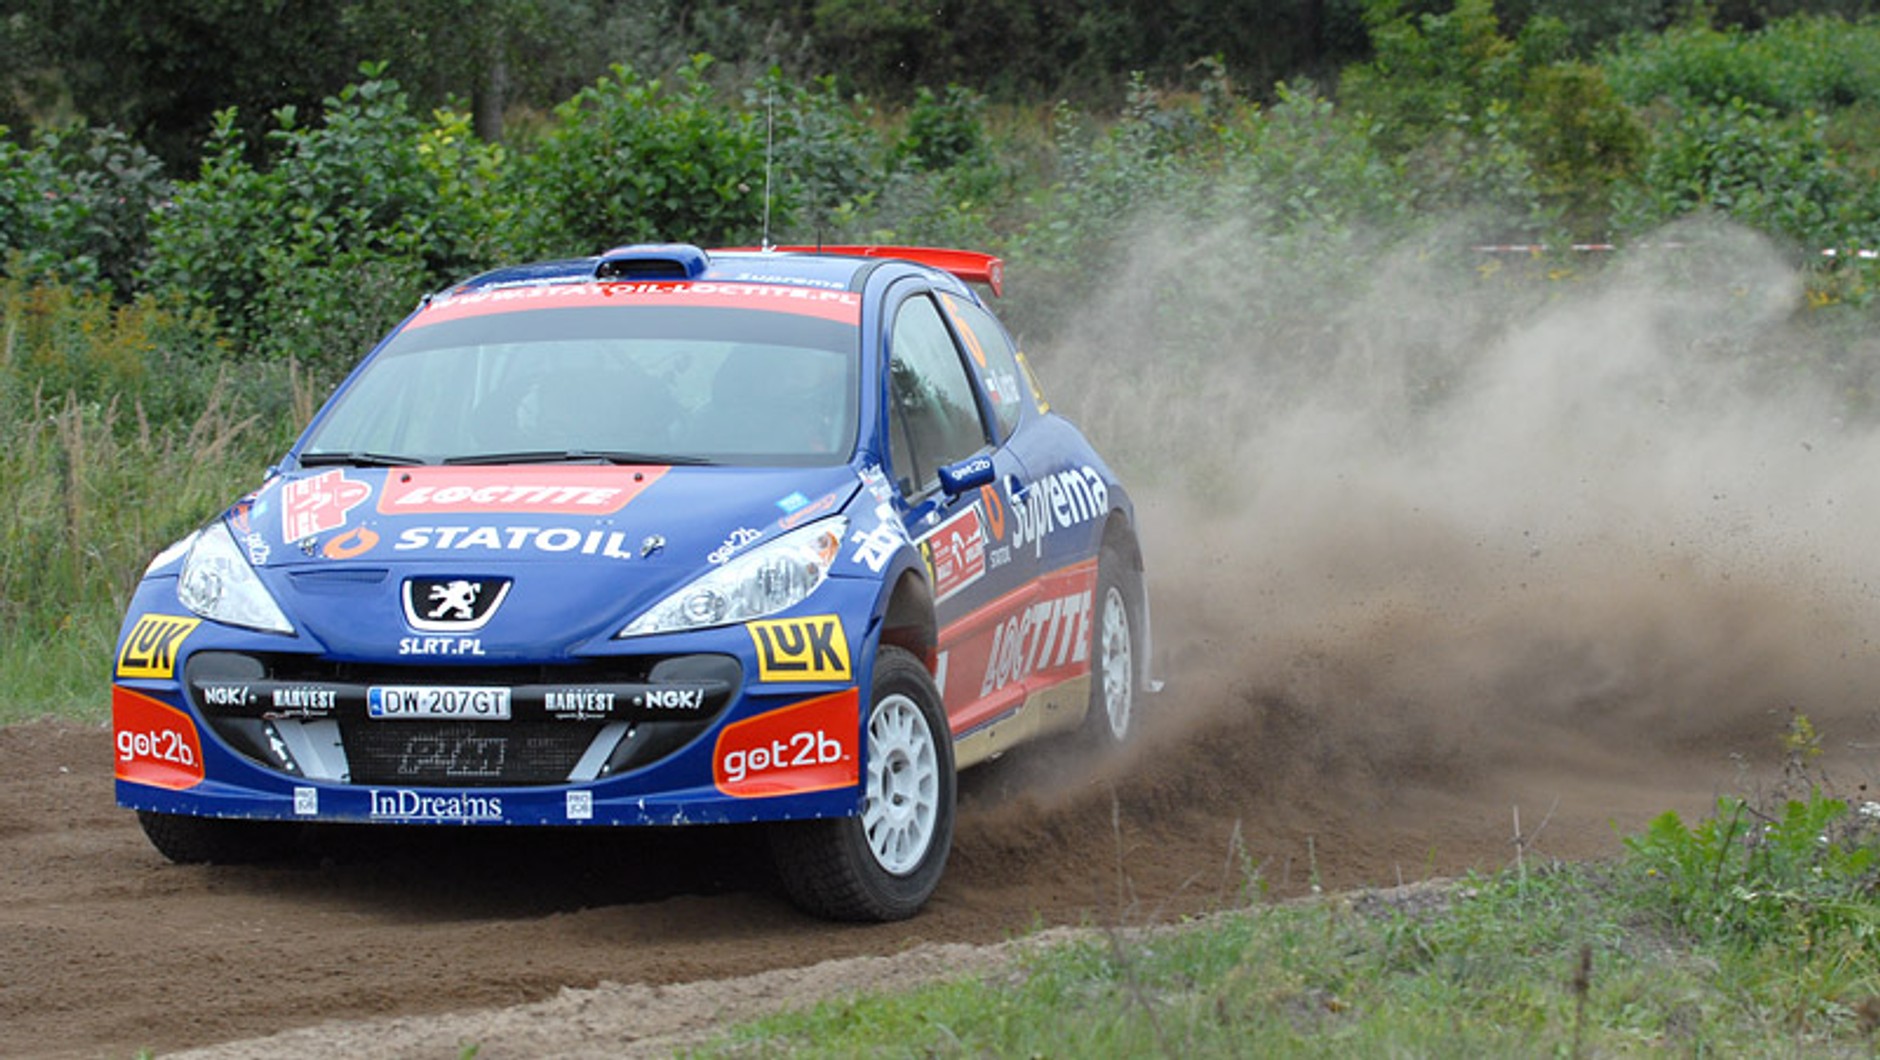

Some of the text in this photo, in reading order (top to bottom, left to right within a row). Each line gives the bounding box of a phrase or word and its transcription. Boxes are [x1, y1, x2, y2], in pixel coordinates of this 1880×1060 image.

[395, 485, 622, 505] LOCTITE
[394, 526, 632, 559] STATOIL
[707, 525, 764, 565] got2b
[398, 637, 486, 656] SLRT.PL
[979, 590, 1093, 698] LOCTITE
[385, 690, 504, 715] DW 207GT
[544, 692, 616, 711] HARVEST
[723, 730, 842, 782] got2b
[369, 788, 502, 817] InDreams
